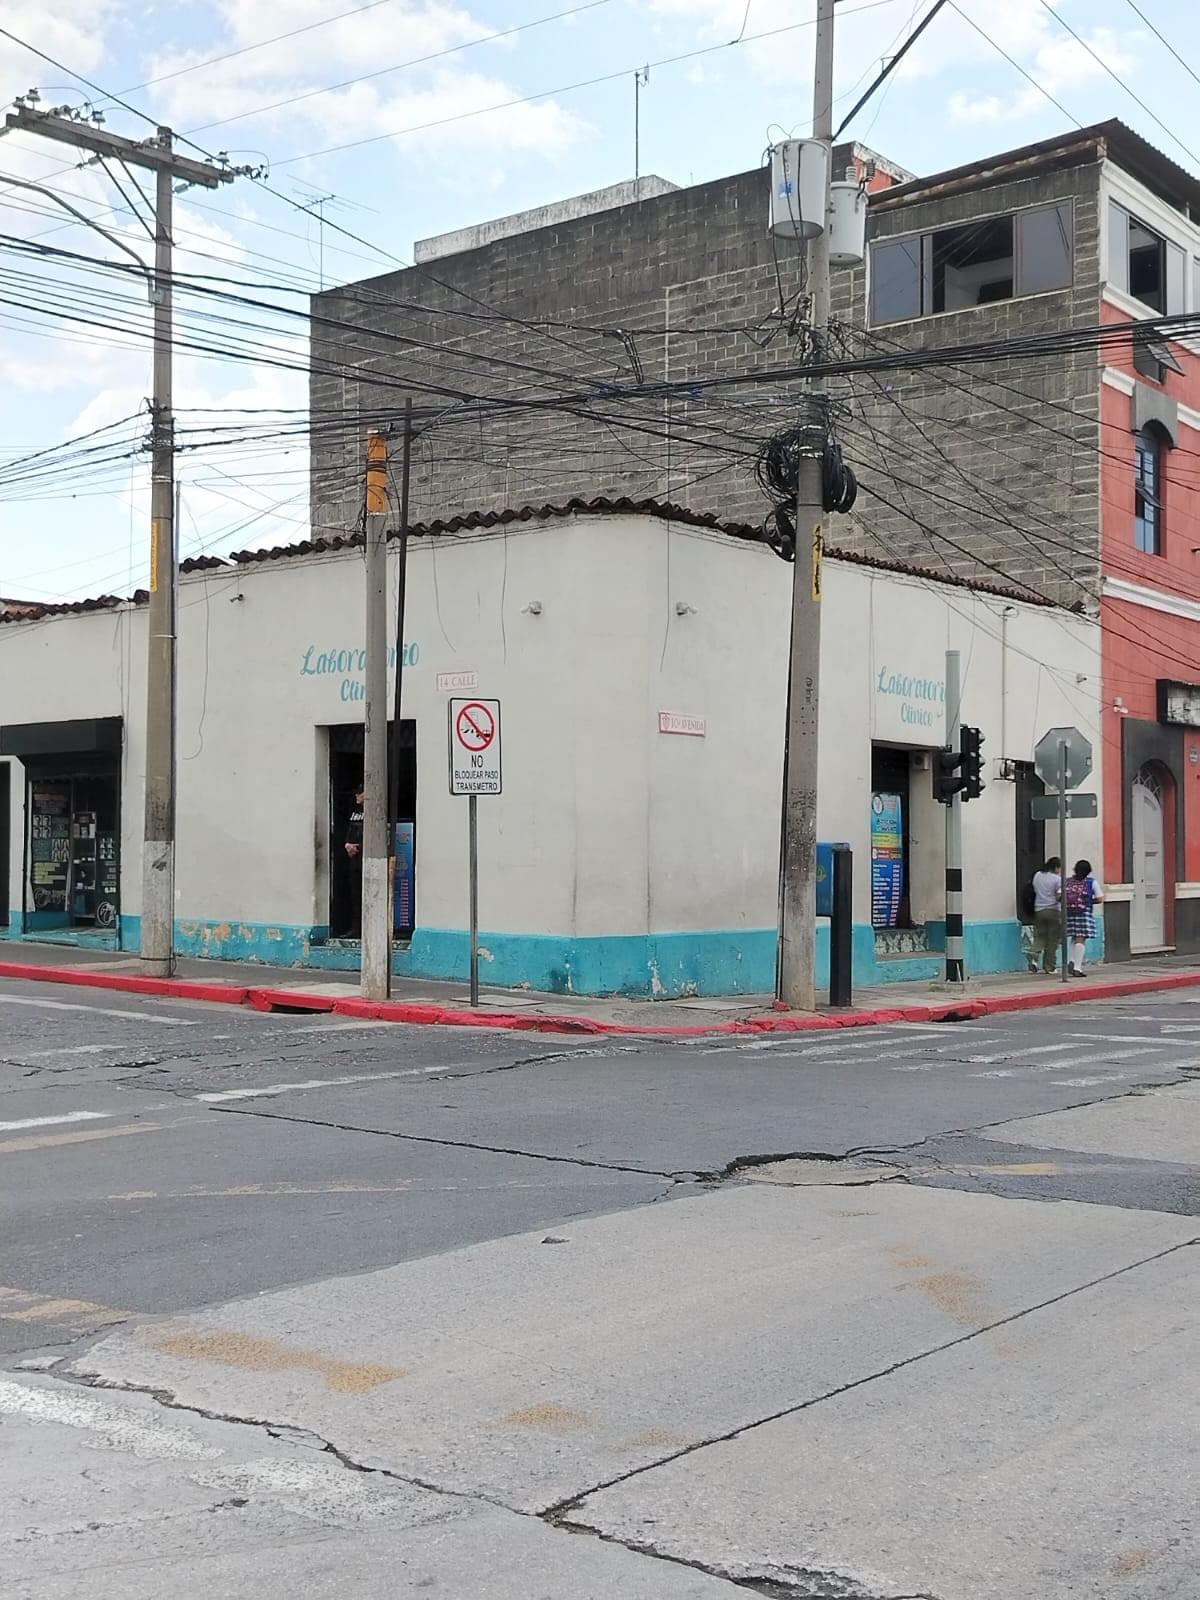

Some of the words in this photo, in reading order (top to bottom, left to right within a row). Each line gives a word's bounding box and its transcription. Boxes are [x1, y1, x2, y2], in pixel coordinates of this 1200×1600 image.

[451, 674, 475, 687] CALLE
[877, 665, 945, 702] Laboratori
[471, 754, 484, 768] NO
[455, 770, 484, 779] BLOQUEAR
[485, 770, 498, 779] PASO
[456, 782, 498, 791] TRANSMETRO
